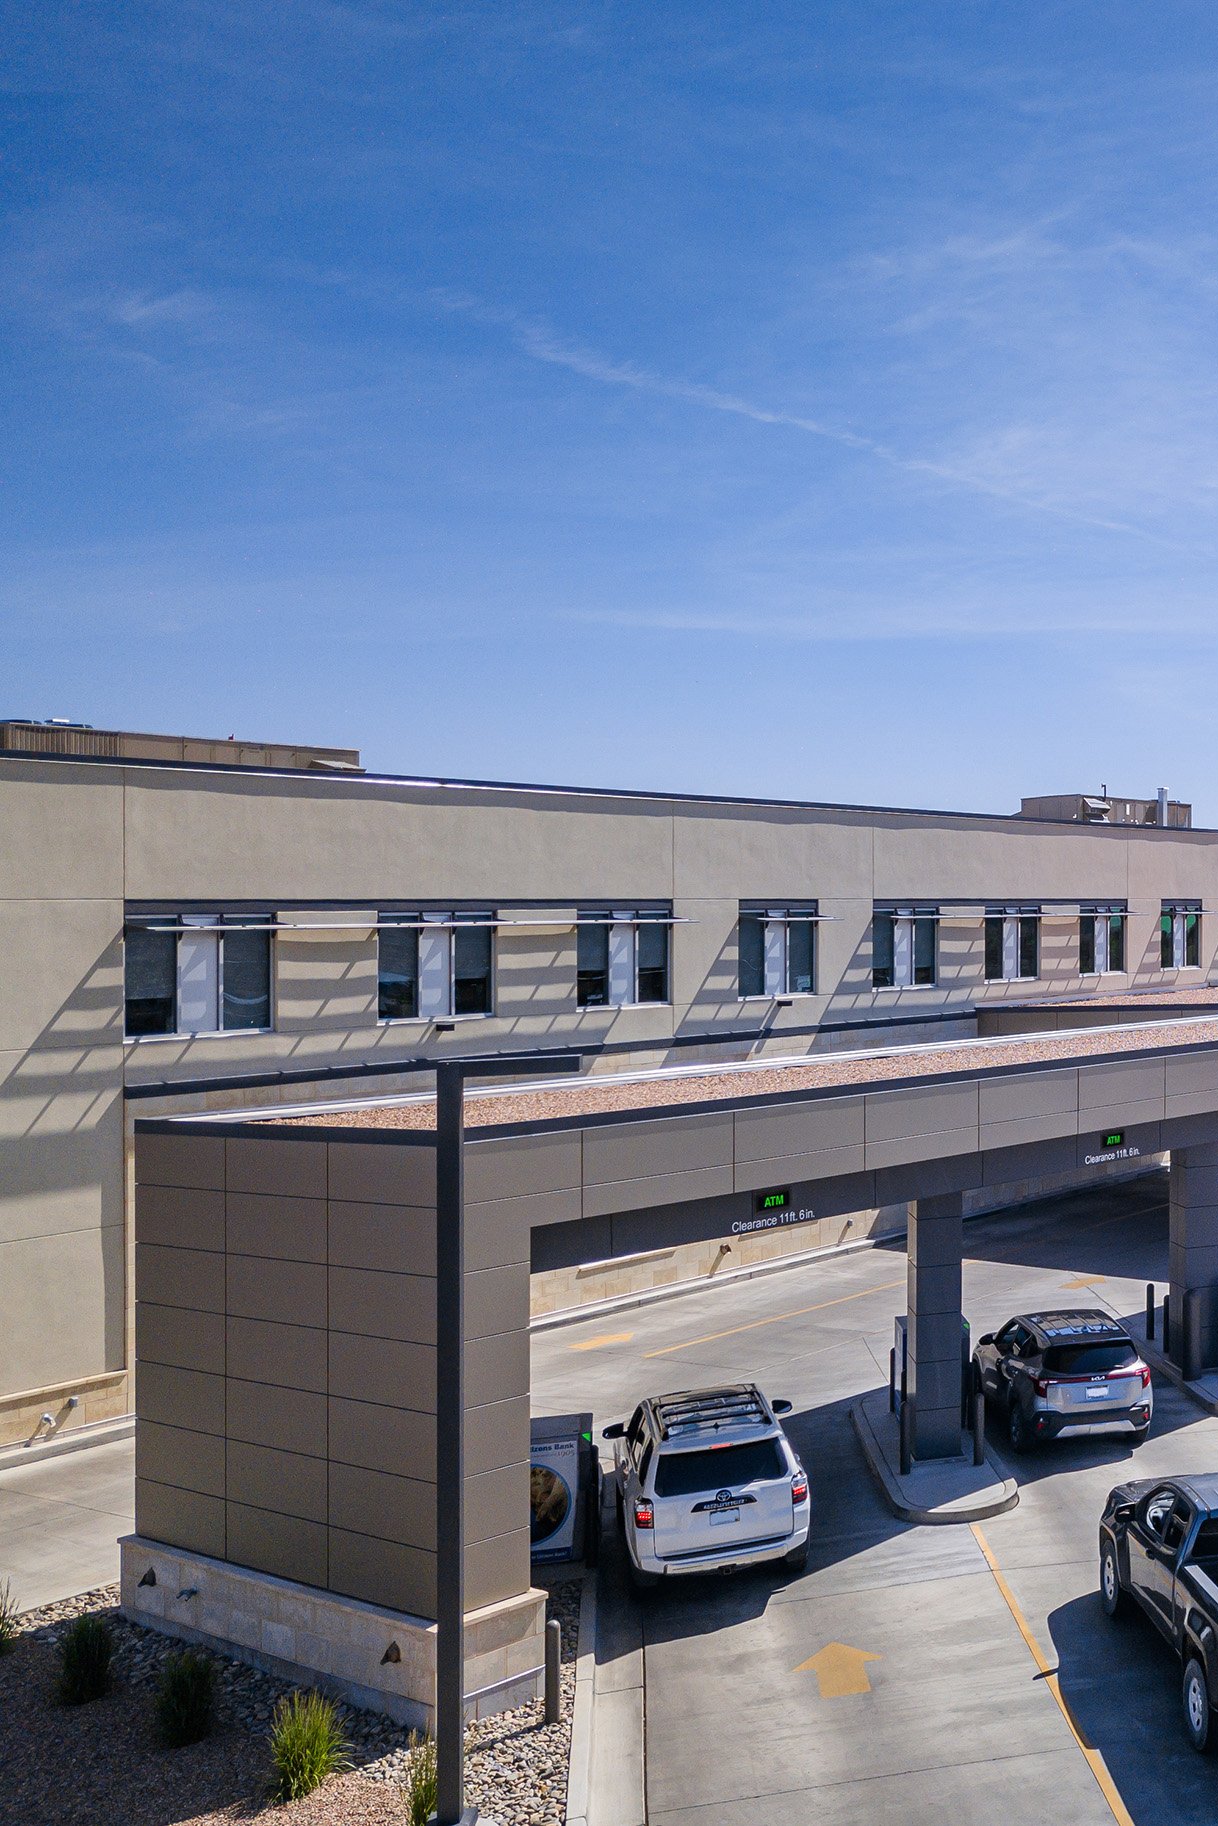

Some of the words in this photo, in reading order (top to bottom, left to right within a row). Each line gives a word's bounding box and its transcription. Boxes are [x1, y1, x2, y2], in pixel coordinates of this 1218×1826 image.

[1107, 1135, 1121, 1146] ATM
[1085, 1153, 1115, 1165] Clearance
[764, 1194, 784, 1208] ATM
[731, 1216, 778, 1233] Clearance
[554, 1442, 574, 1451] Bank
